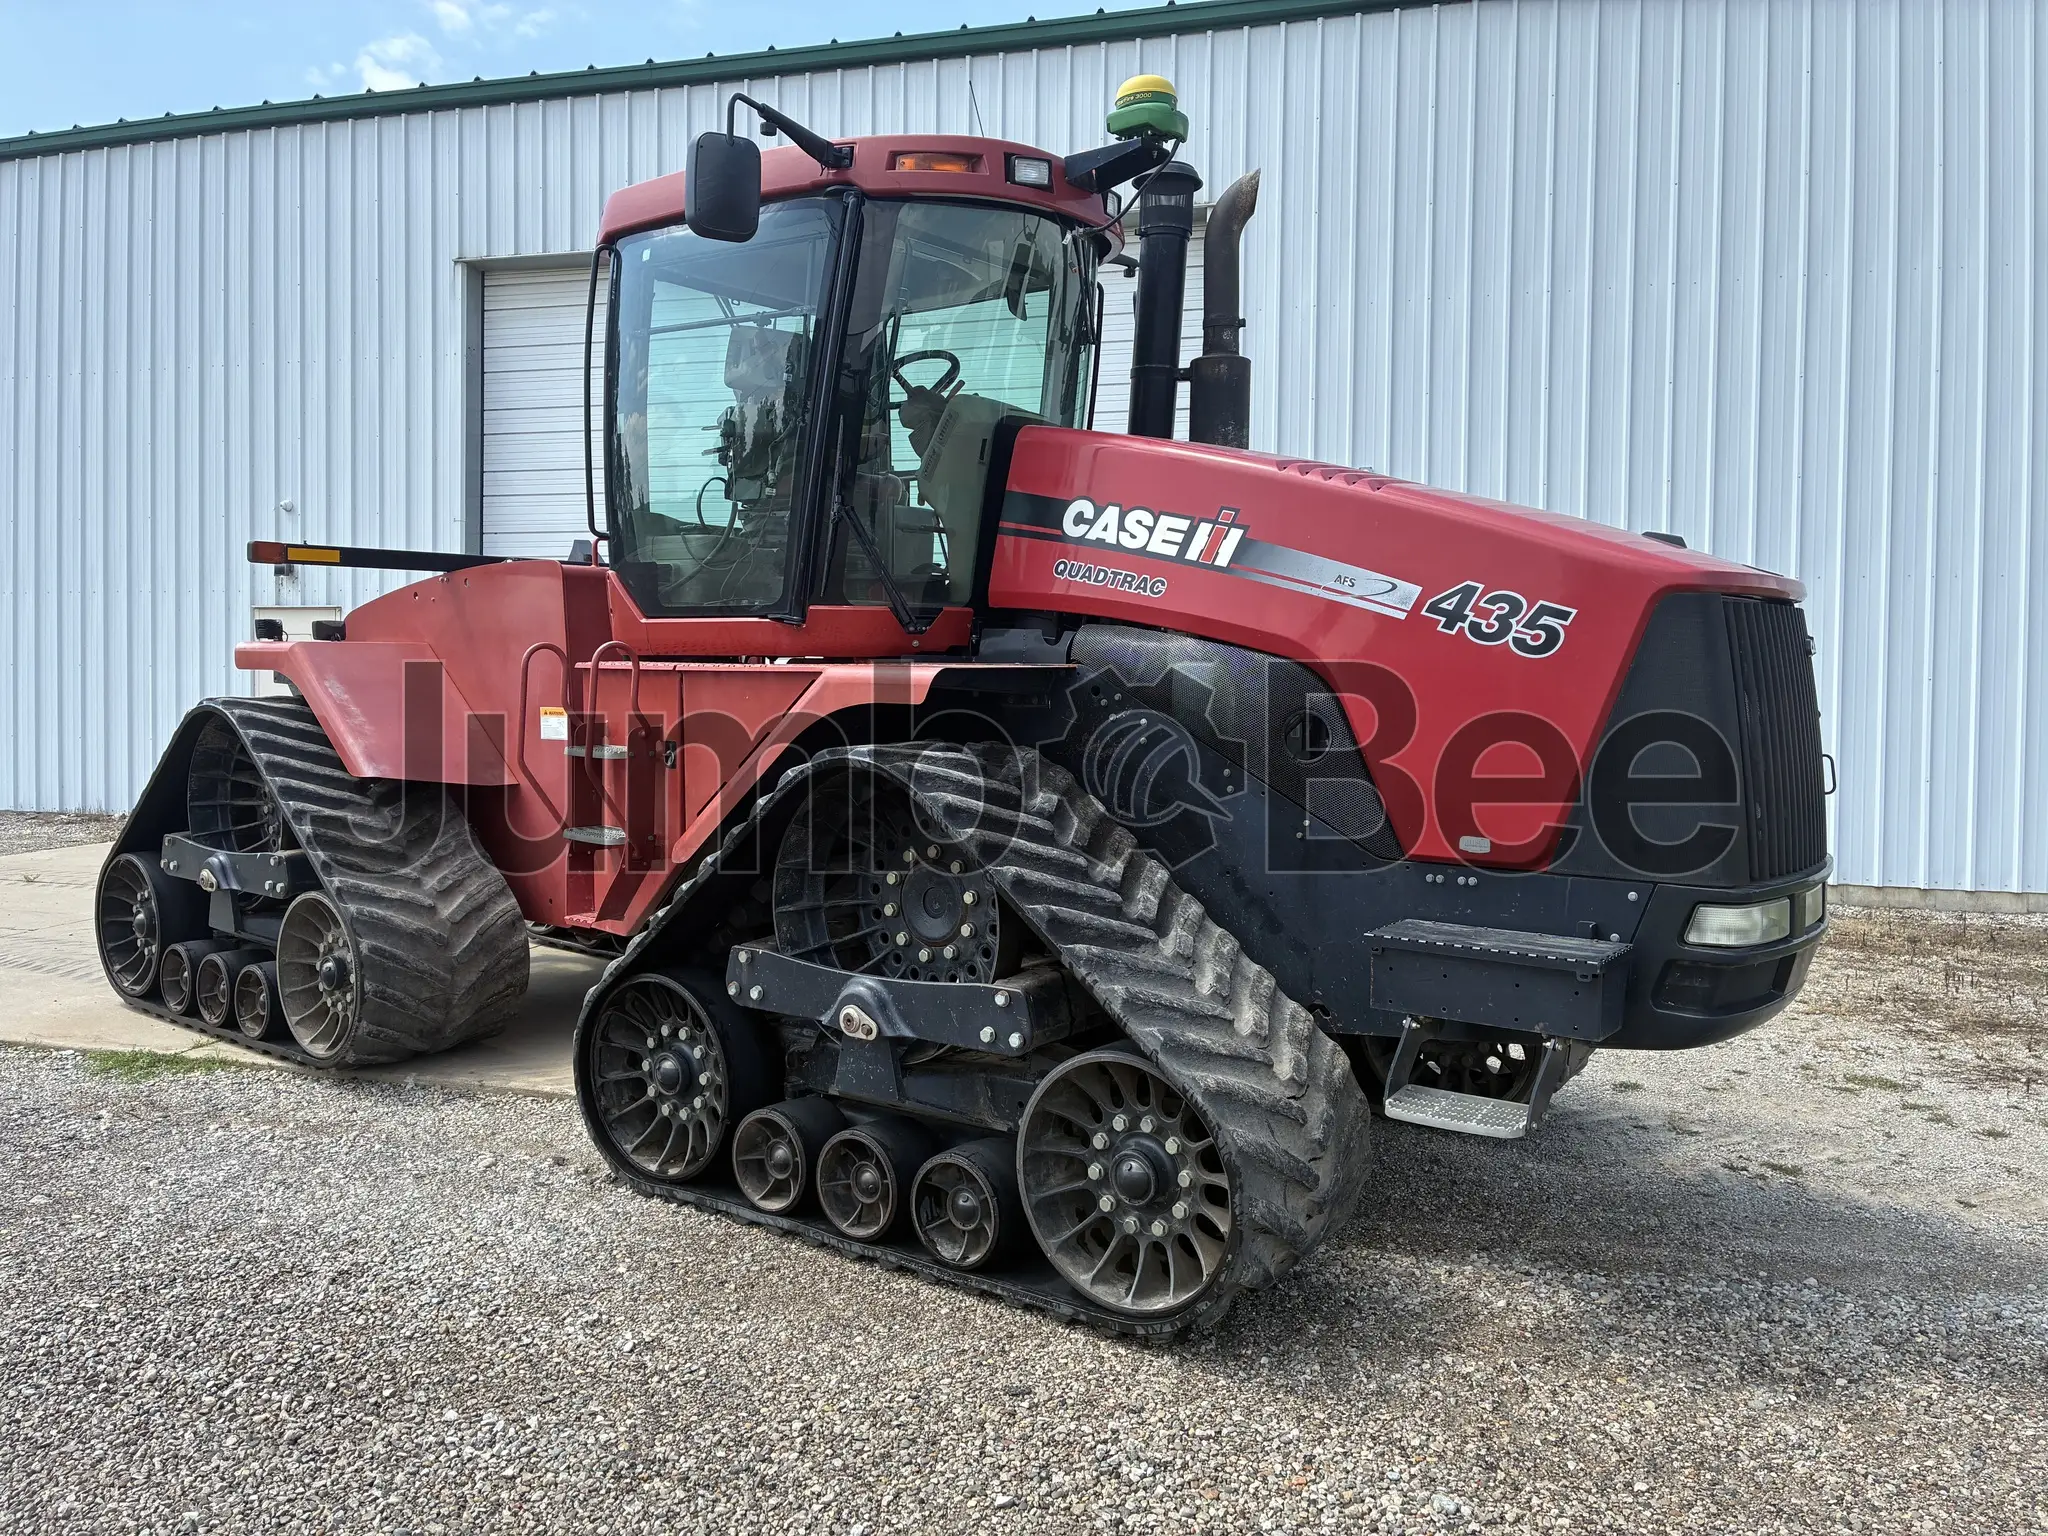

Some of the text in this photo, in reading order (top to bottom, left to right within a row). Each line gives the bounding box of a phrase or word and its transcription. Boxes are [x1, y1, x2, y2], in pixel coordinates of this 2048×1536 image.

[1135, 92, 1152, 100] 3000
[1062, 499, 1192, 557] CASE
[1053, 559, 1168, 598] QUADTRAC
[1334, 574, 1356, 588] AFS
[1420, 580, 1579, 659] 435
